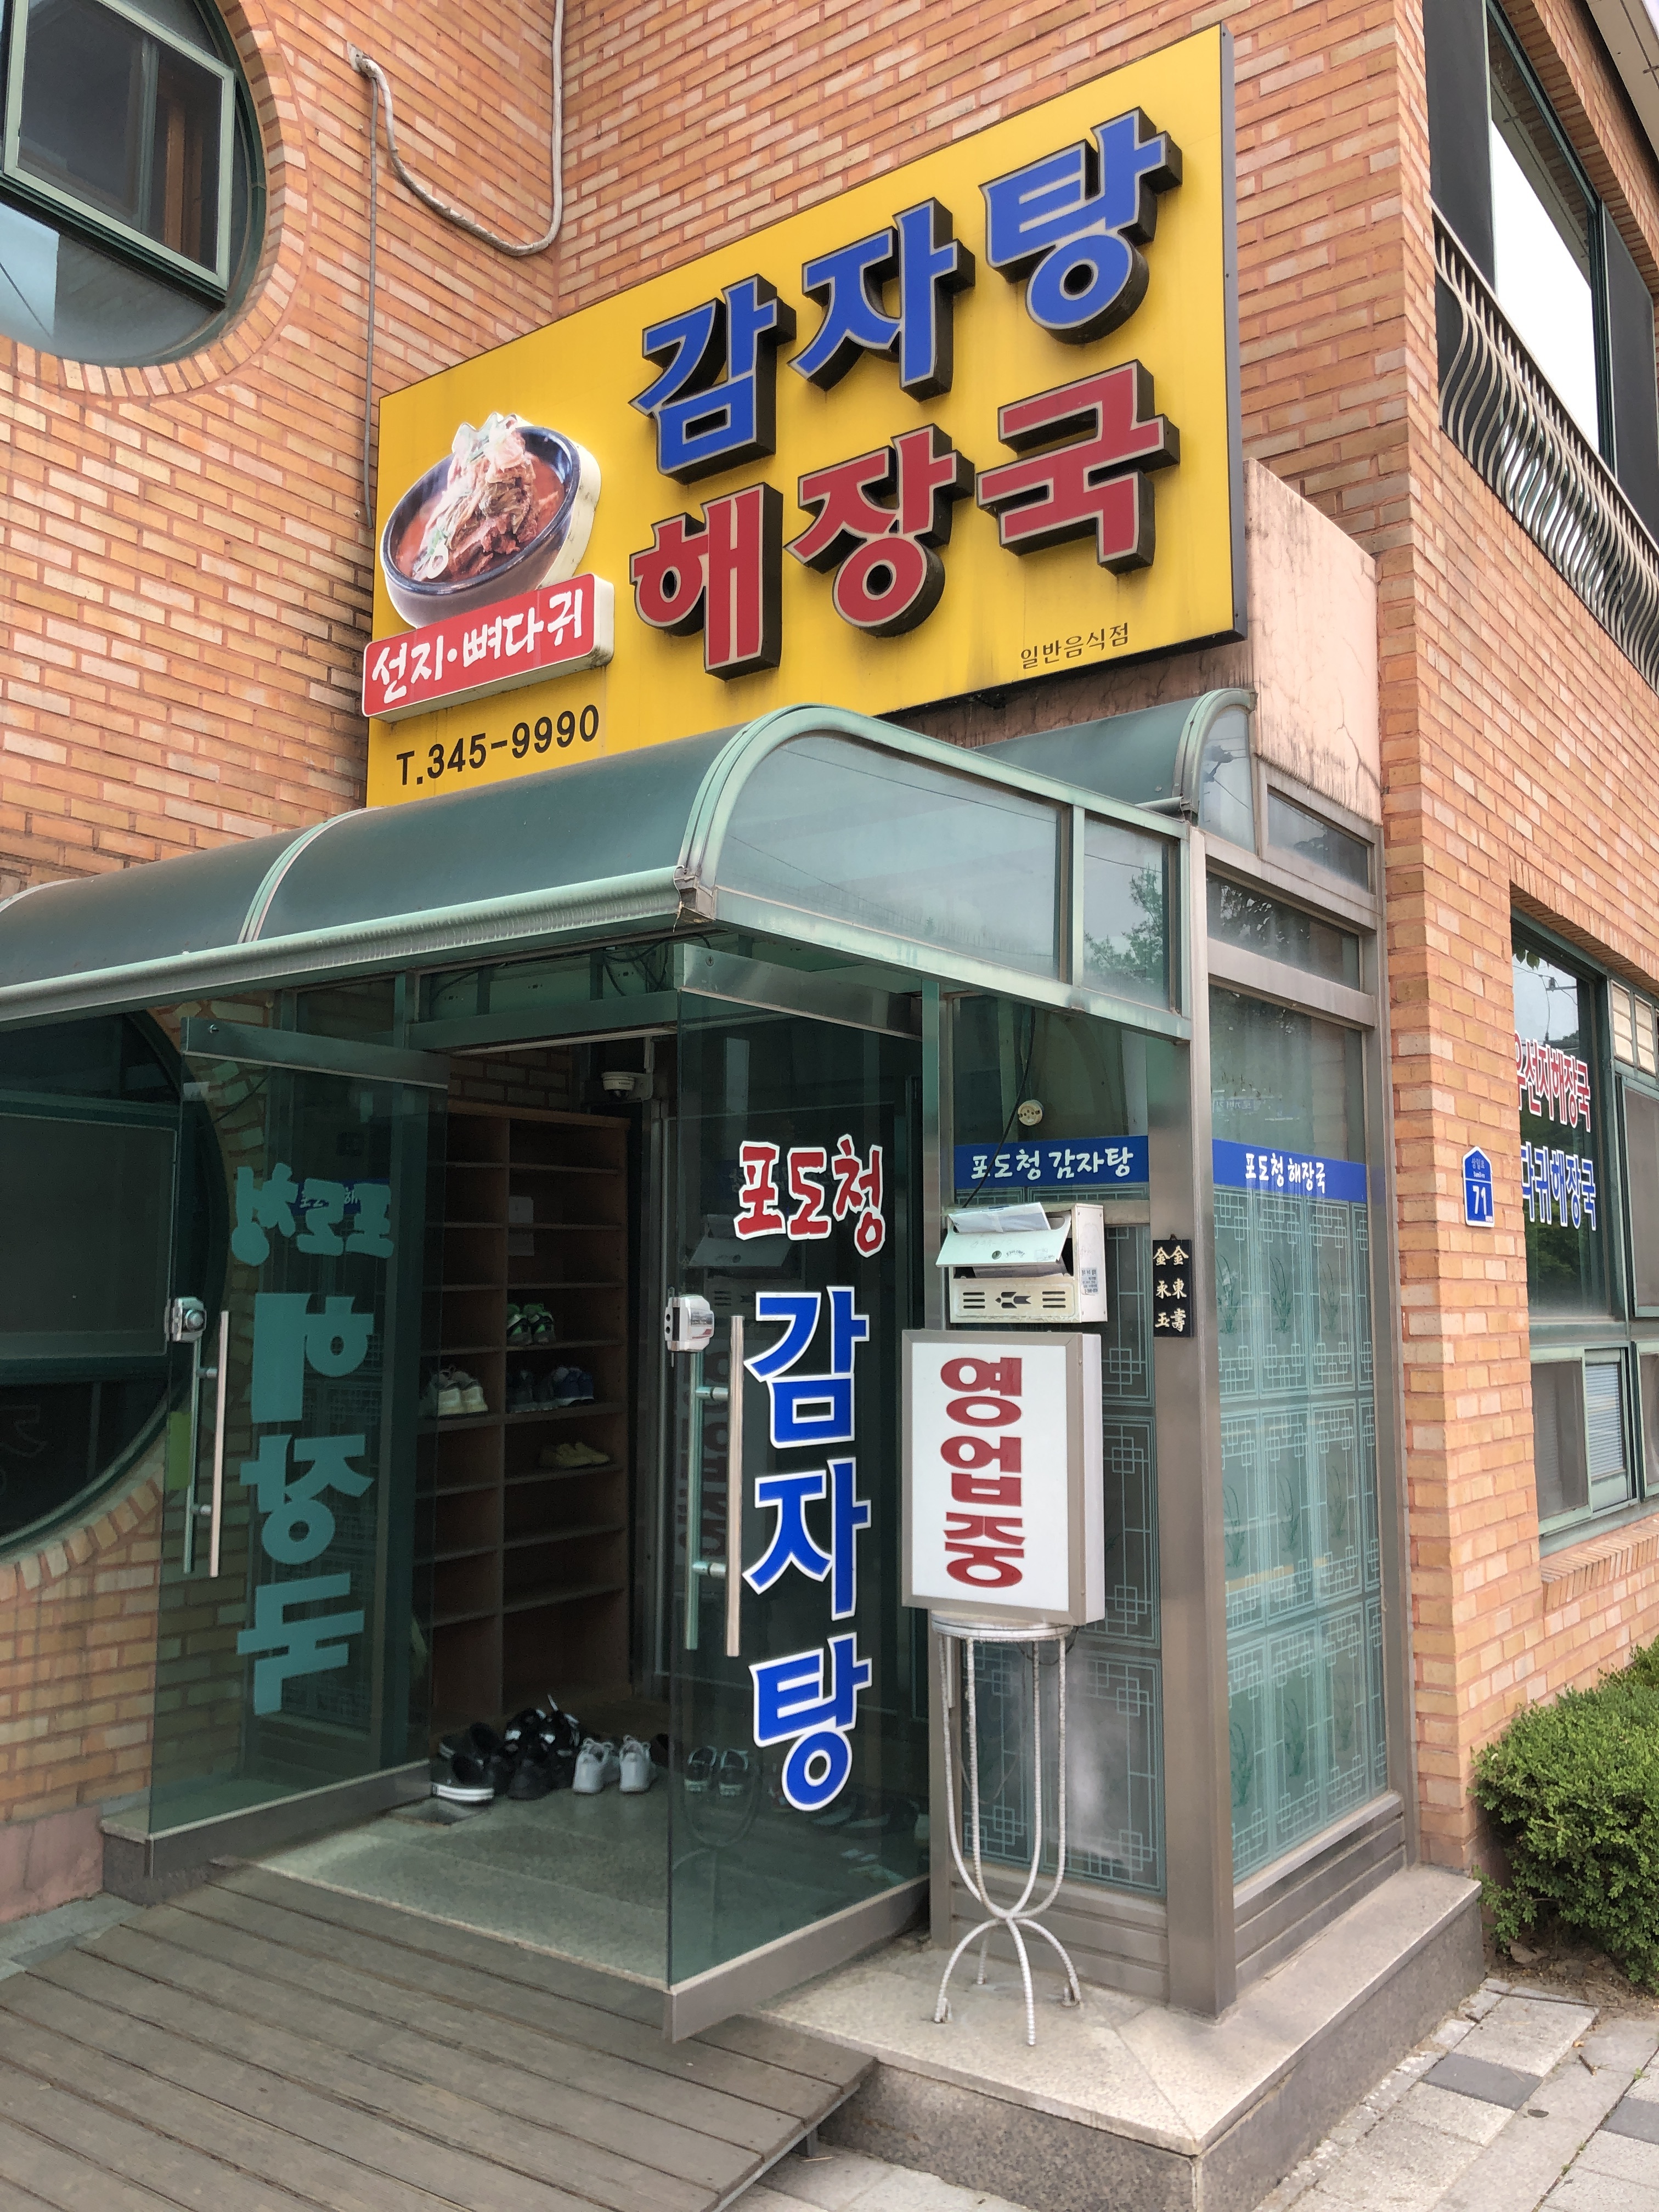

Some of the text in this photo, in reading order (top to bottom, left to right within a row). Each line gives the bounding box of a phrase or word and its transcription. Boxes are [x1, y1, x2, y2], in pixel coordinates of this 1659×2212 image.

[629, 106, 1171, 483] 감자탕
[629, 359, 1172, 678] 해장국
[370, 589, 583, 704] 선지·뼈다귀
[1019, 623, 1130, 670] 일반음식점
[396, 704, 600, 787] T.345-9990
[733, 1133, 885, 1257] 포도청
[970, 1146, 1134, 1181] 포도청 감자탕
[1245, 1152, 1326, 1194] 포도청 해장국
[1472, 1185, 1487, 1216] 71
[1169, 1244, 1189, 1333] 金東壽
[940, 1356, 1026, 1588] 영업중
[742, 1285, 872, 1812] 감자탕
